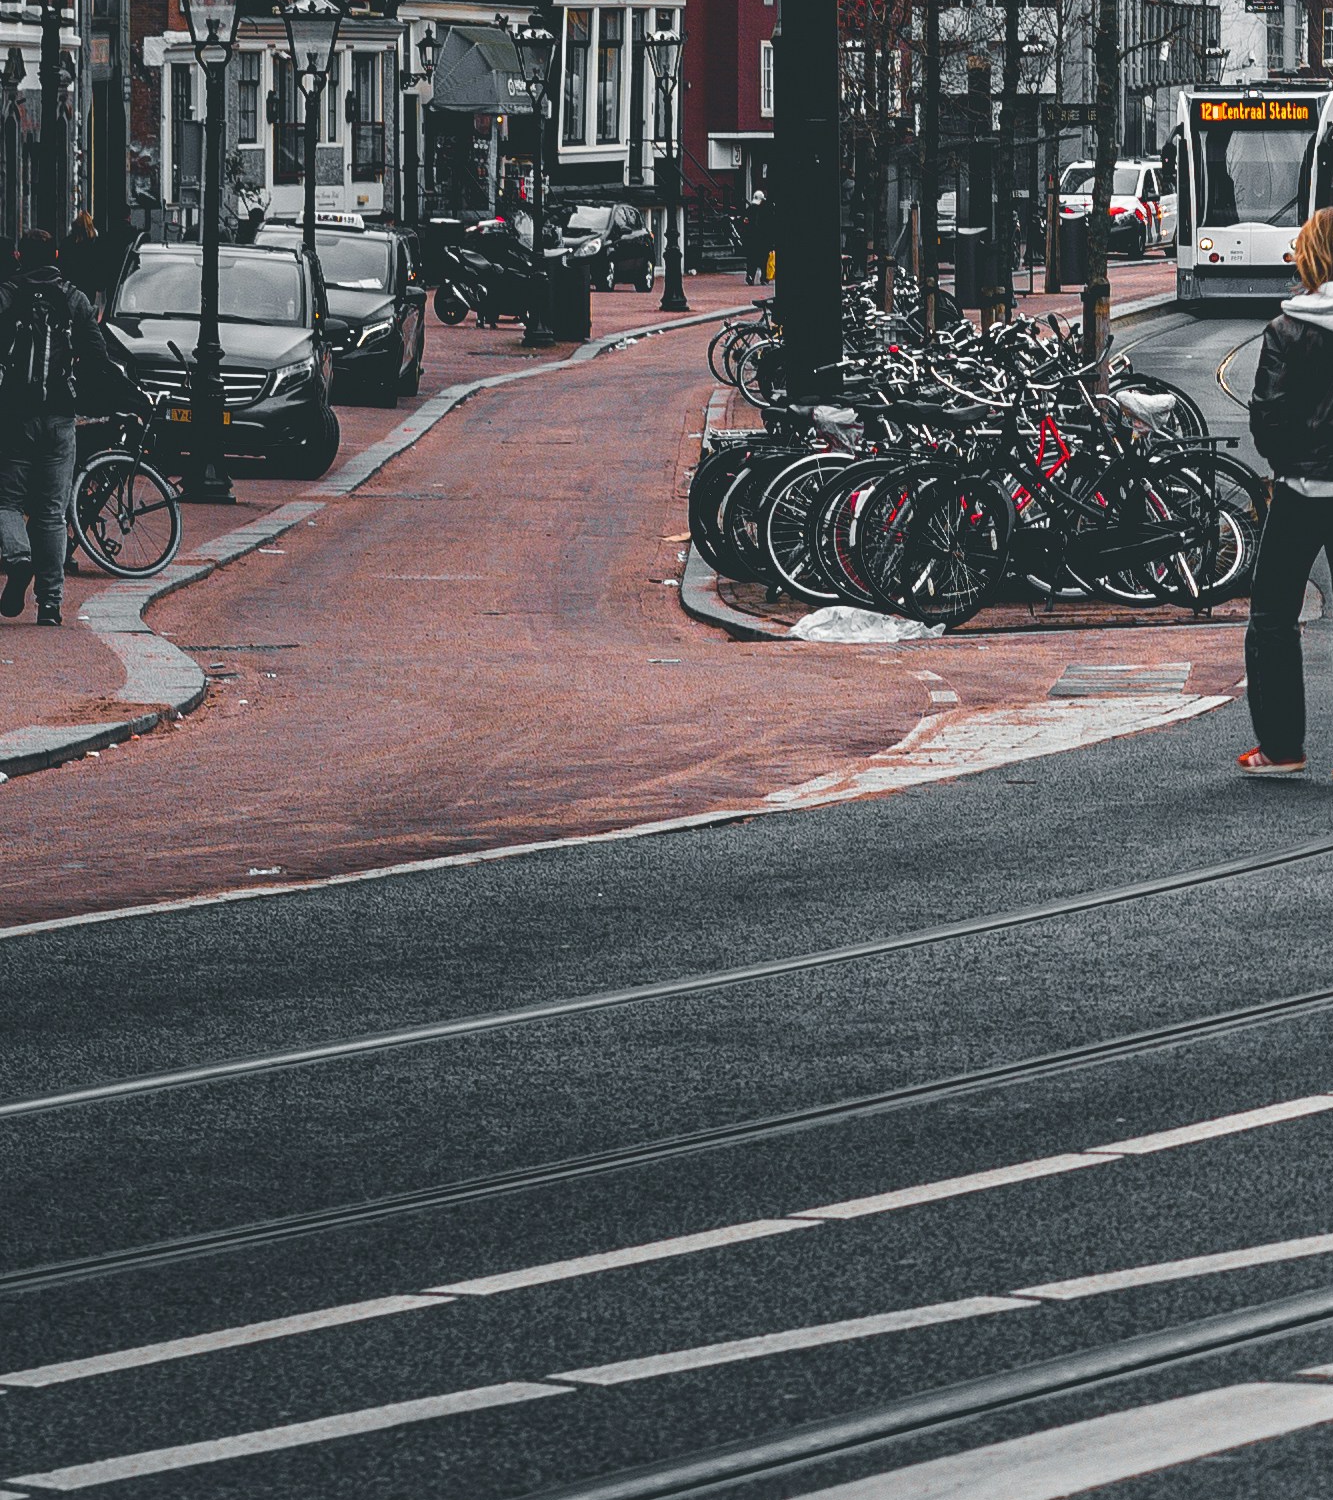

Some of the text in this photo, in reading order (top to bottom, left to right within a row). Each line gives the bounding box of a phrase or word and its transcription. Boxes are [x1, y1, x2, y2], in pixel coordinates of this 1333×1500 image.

[1201, 101, 1309, 120] 12 Centraal Station
